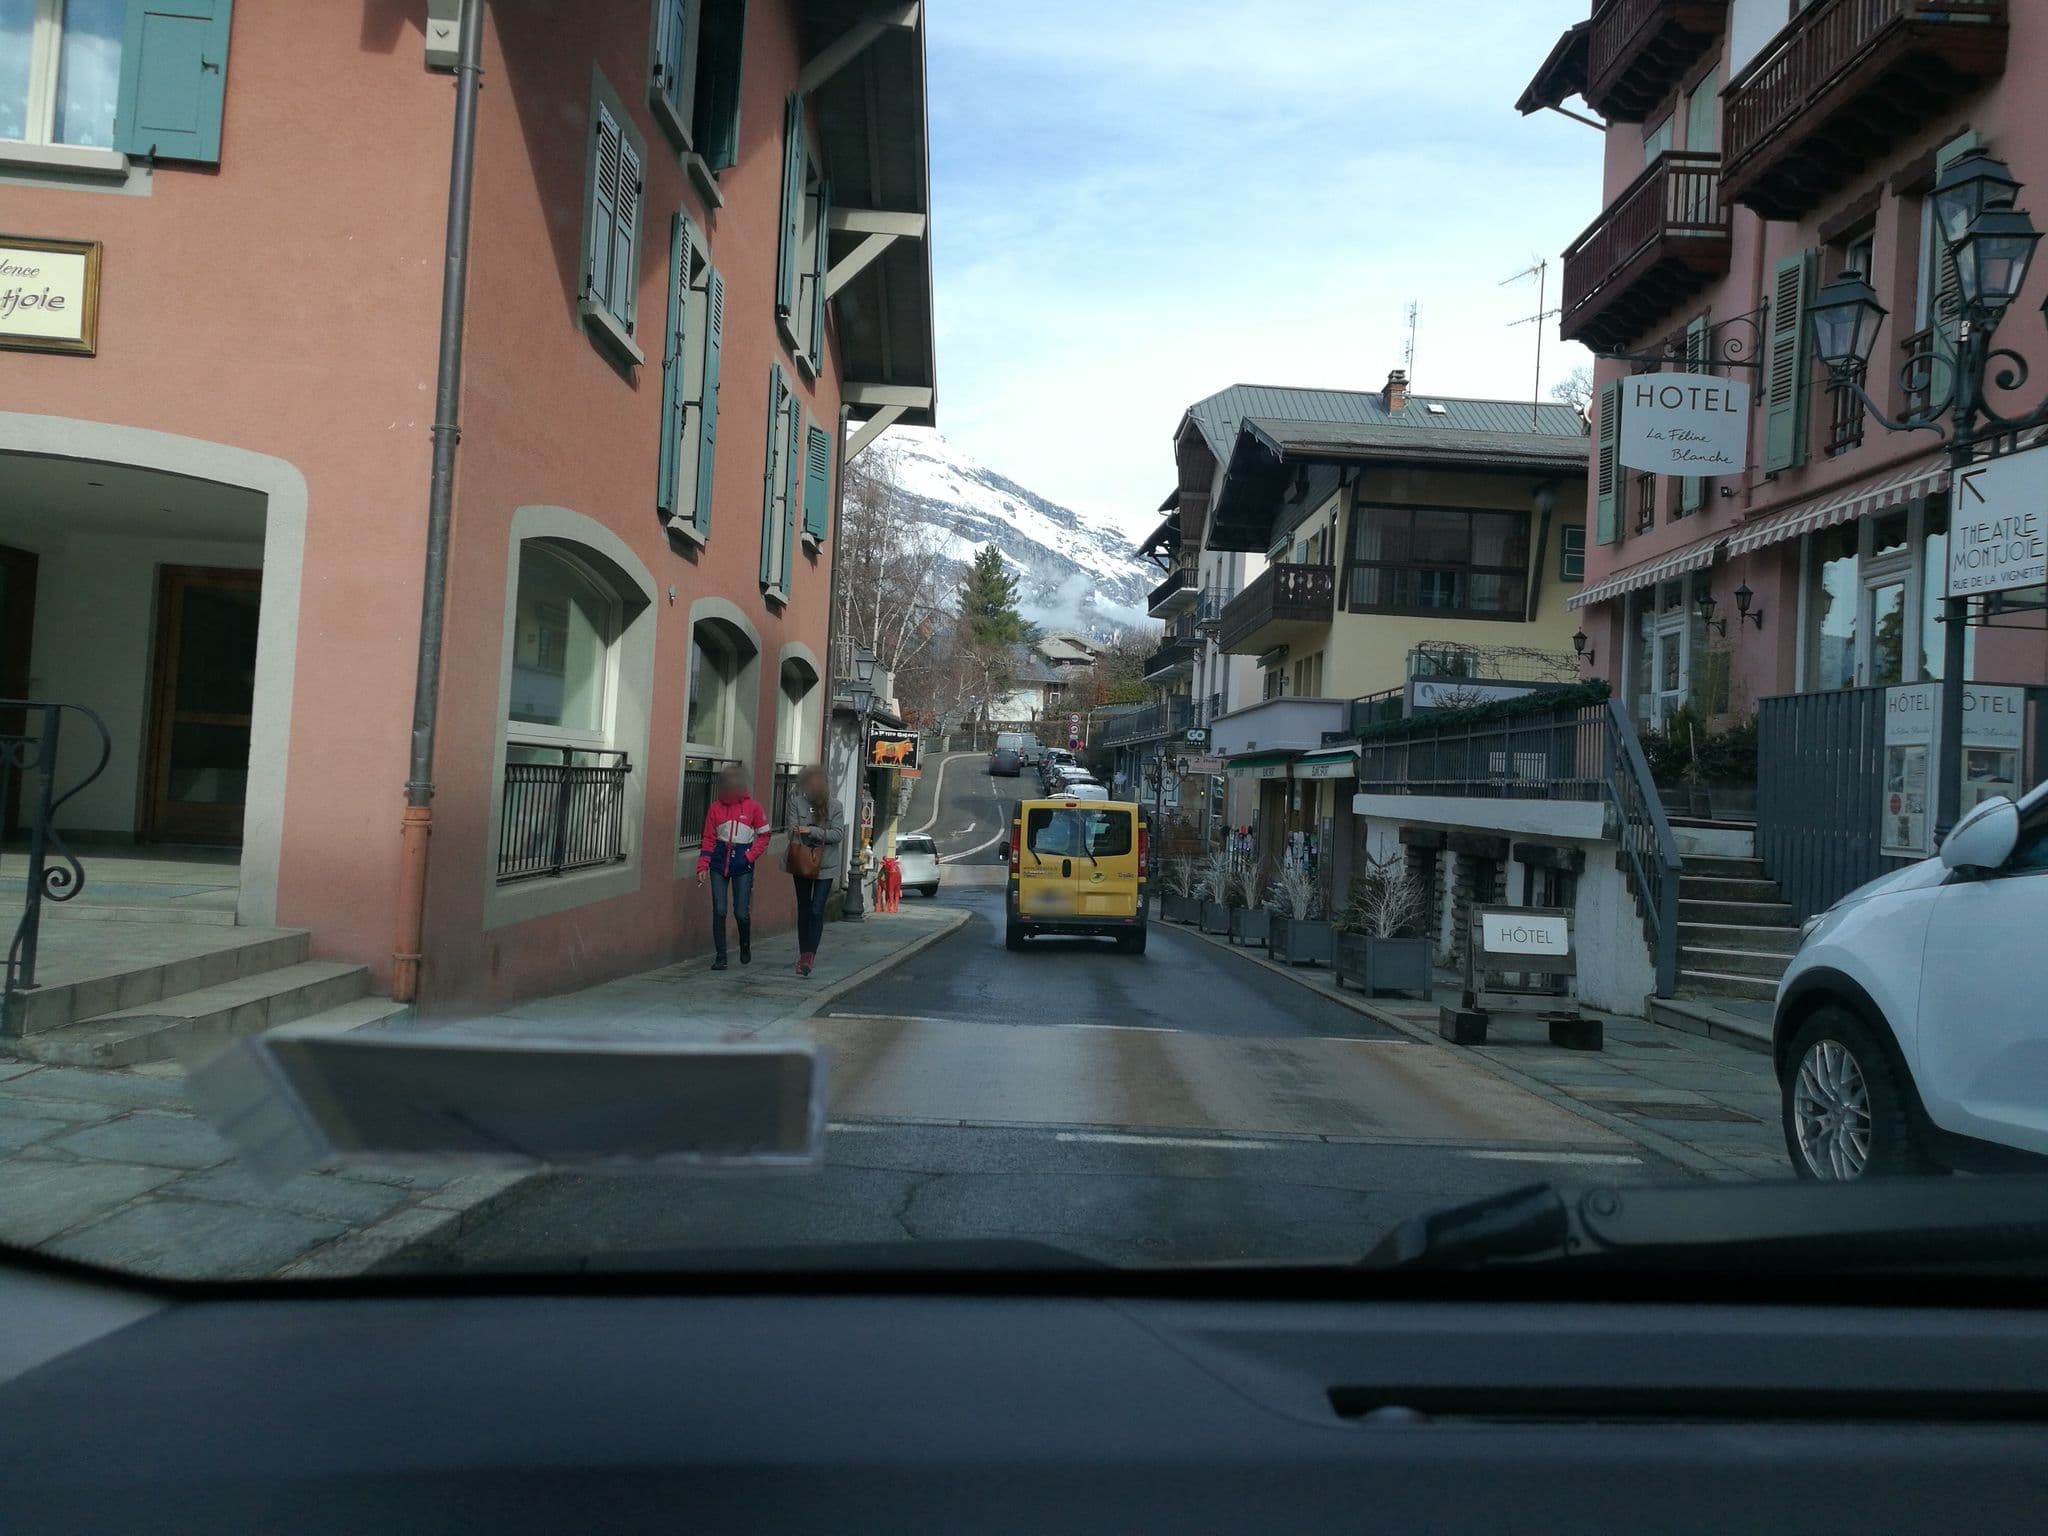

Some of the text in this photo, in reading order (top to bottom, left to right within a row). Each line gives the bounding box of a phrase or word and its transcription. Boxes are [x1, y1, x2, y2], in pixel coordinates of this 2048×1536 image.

[1636, 384, 1738, 413] HOTEL
[1646, 427, 1712, 443] La Féline
[1671, 448, 1734, 464] Blanche
[1960, 513, 2038, 550] THEATRE
[1952, 537, 2044, 573] MONTJOIE
[1952, 565, 2046, 590] RUE DE LA VIGNETTE
[1888, 692, 1930, 713] HÔTEL
[1962, 691, 2017, 714] ÔTEL
[1187, 729, 1206, 741] GO
[1501, 926, 1553, 944] HÔTEL
